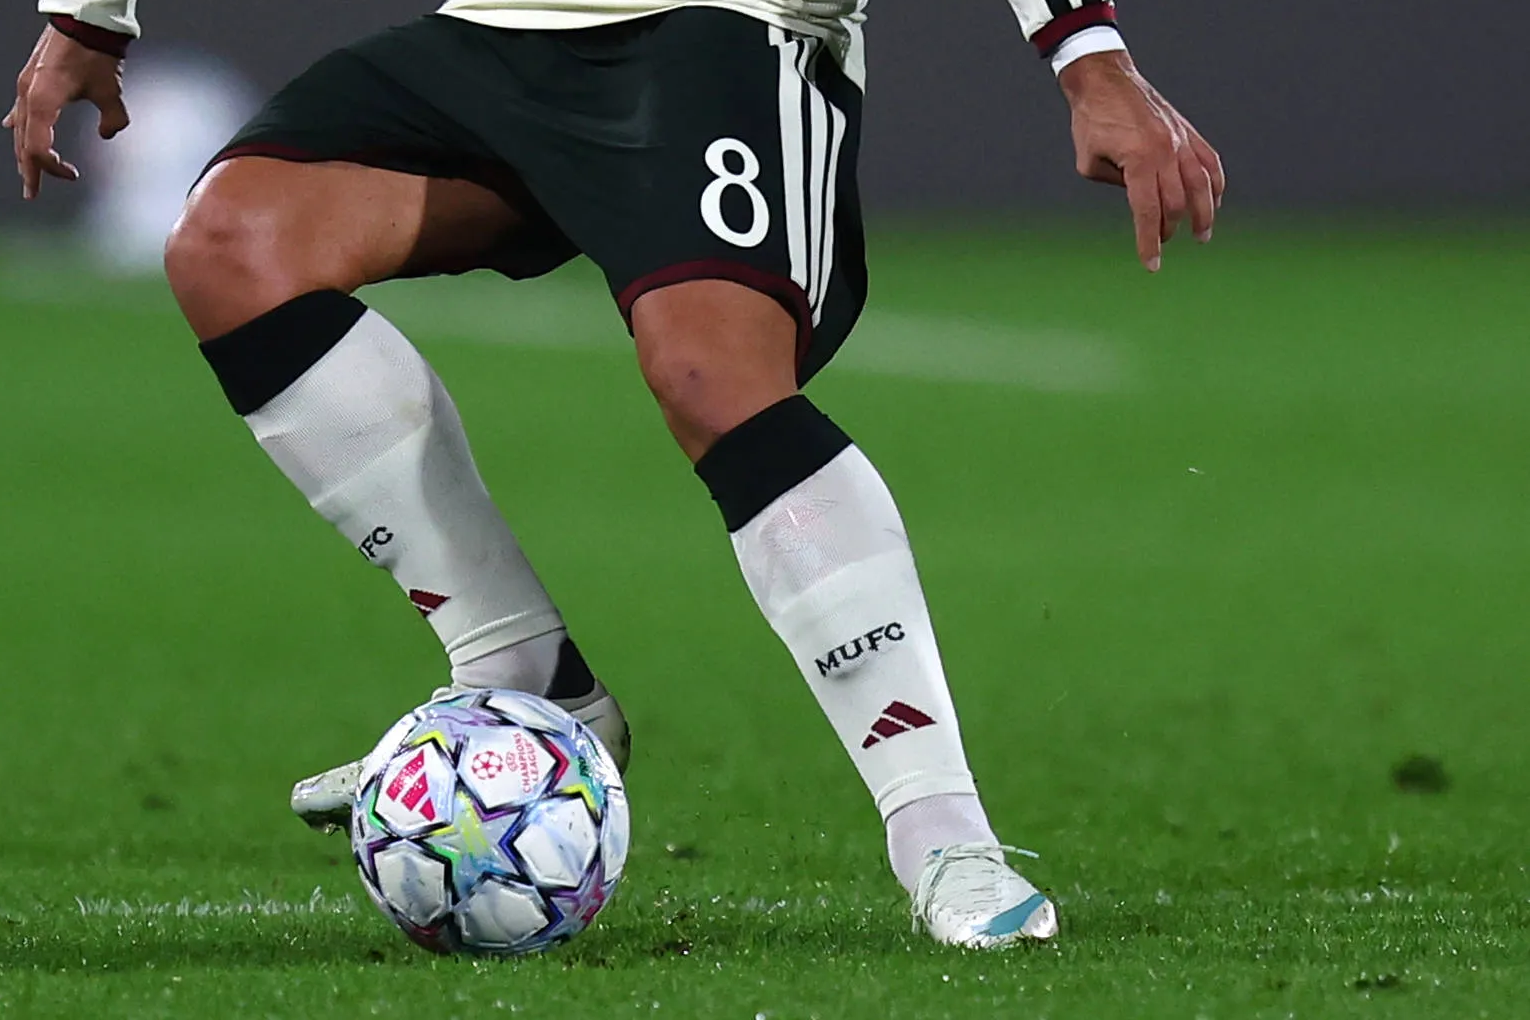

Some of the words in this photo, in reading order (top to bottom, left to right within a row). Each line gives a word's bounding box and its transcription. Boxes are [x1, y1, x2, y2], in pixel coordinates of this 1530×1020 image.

[700, 137, 770, 248] 8
[358, 526, 394, 561] FC
[814, 621, 906, 678] MUFC
[513, 733, 532, 794] CHAMPIONS
